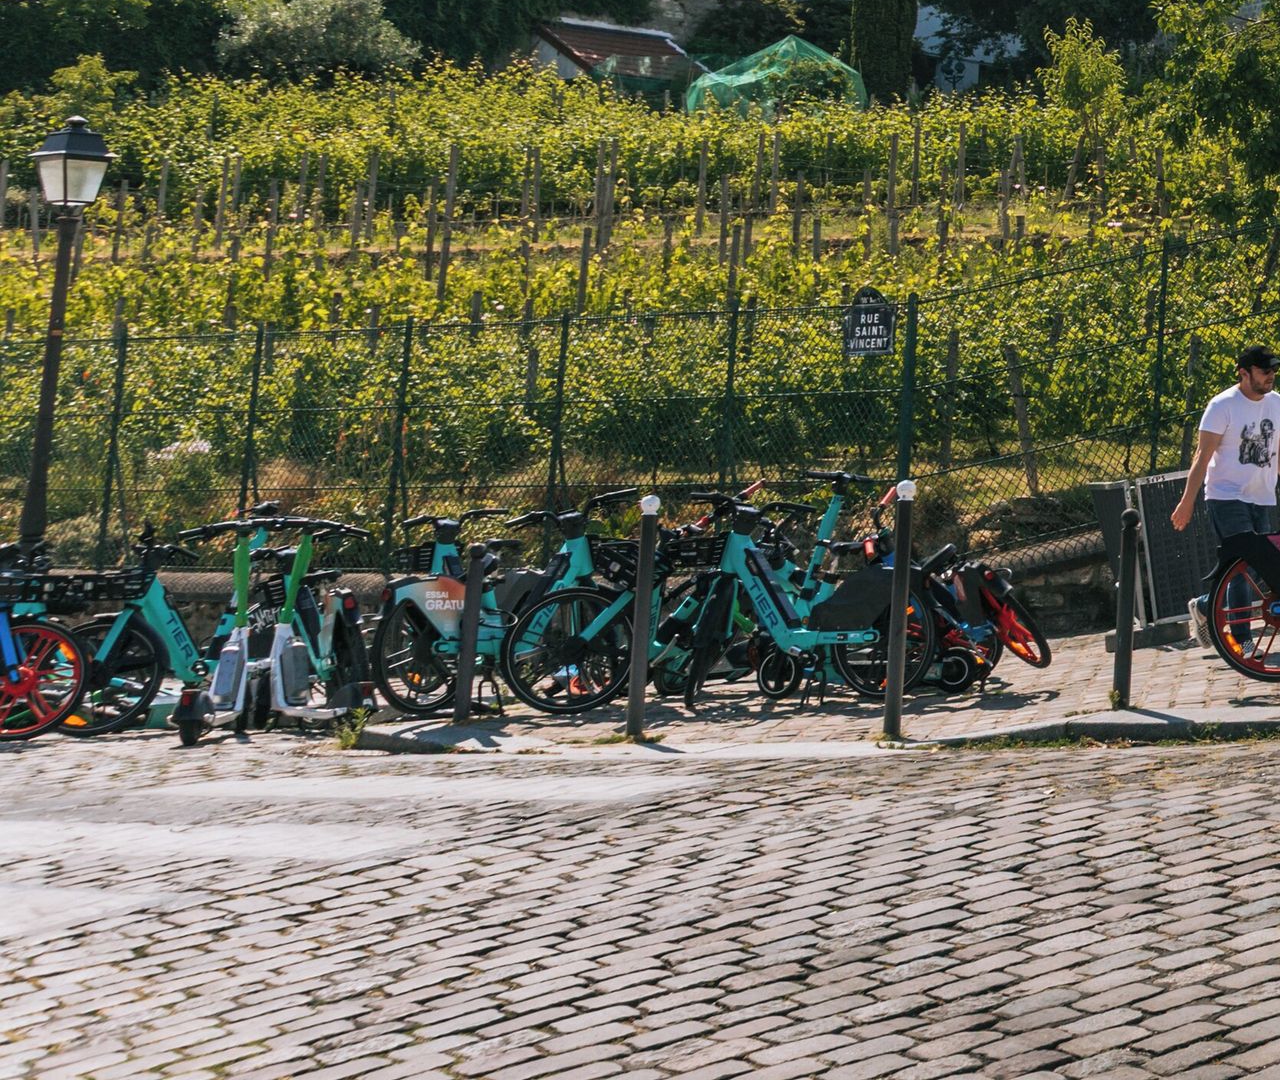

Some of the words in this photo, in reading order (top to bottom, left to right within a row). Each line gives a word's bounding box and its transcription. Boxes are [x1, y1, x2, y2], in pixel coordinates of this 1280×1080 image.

[860, 313, 880, 324] RUE
[855, 325, 884, 337] SAINT
[849, 337, 888, 349] VINCENT
[425, 591, 449, 599] ESSAI
[425, 599, 465, 610] GRATU
[749, 577, 779, 629] TIER
[166, 611, 194, 660] TIER
